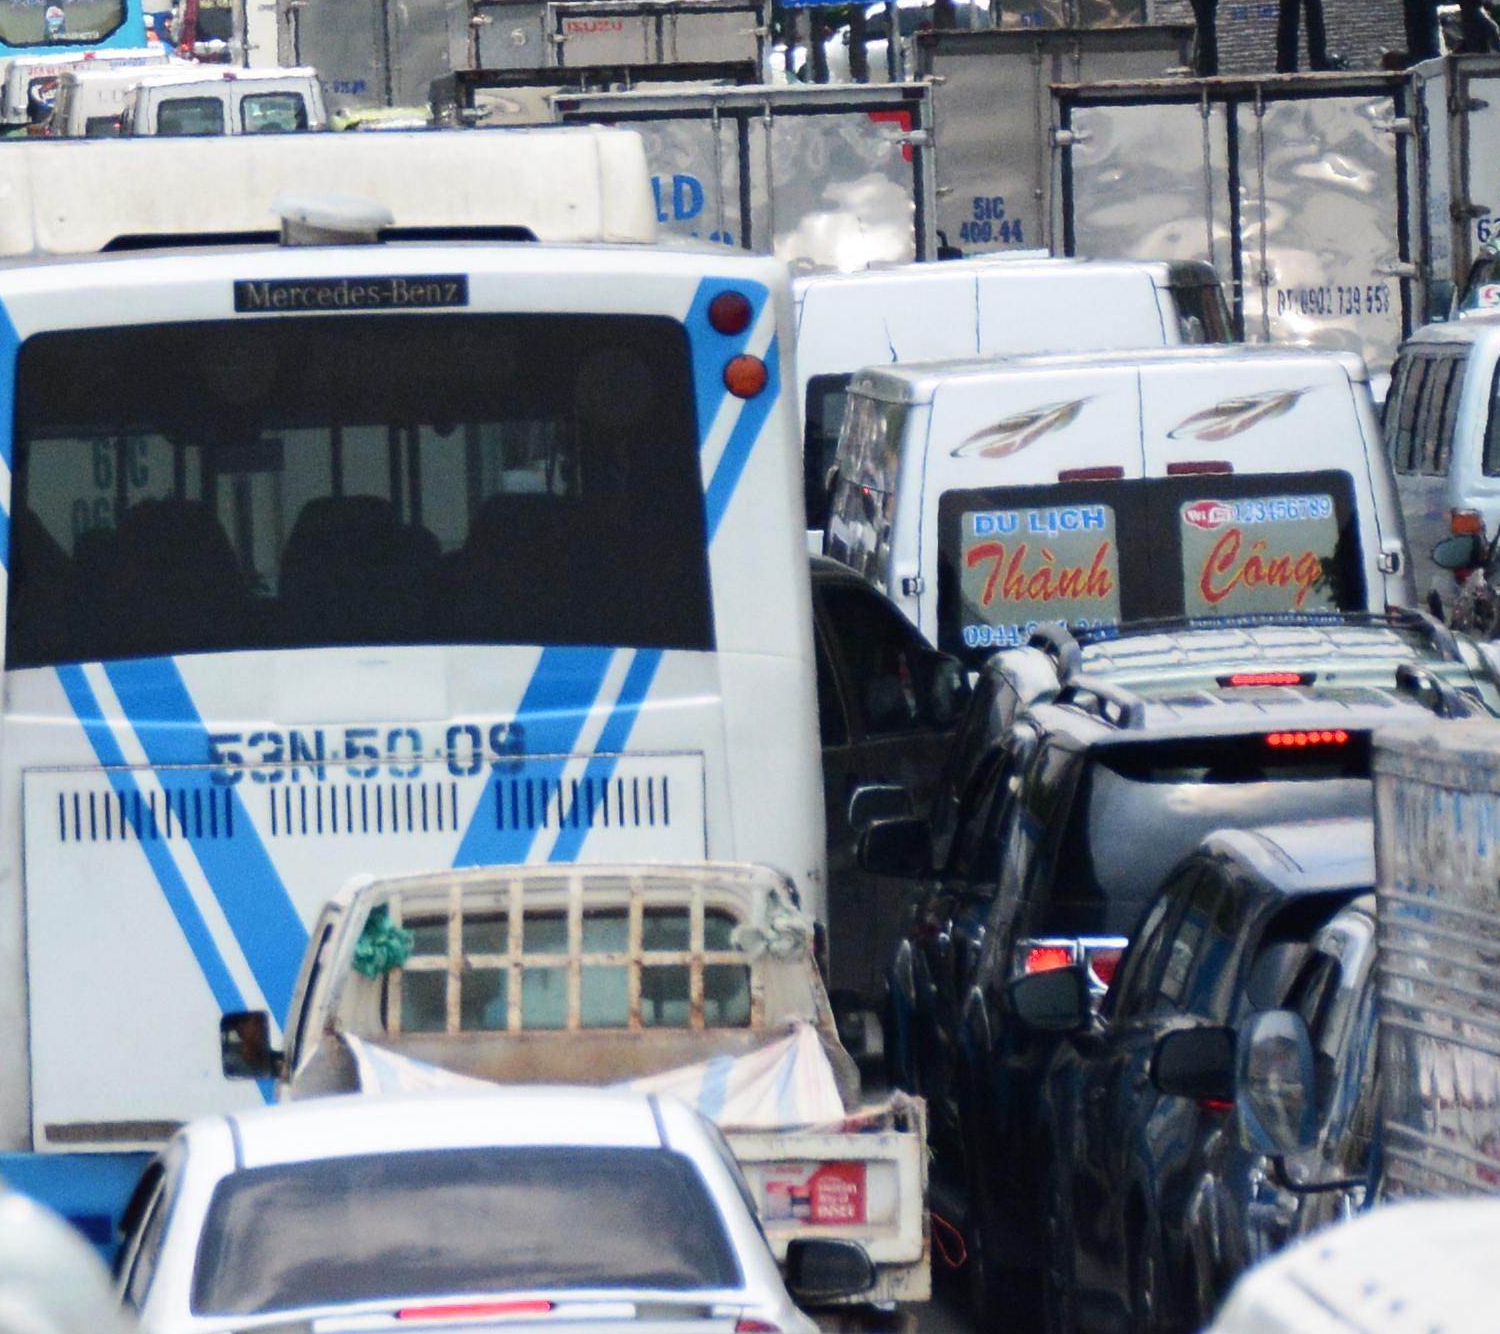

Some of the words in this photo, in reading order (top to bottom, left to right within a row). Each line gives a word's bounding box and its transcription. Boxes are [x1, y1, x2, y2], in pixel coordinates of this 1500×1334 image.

[972, 196, 1005, 221] 51C
[246, 278, 458, 307] Mercedes-Benz
[974, 512, 1018, 536] DU
[1028, 505, 1106, 538] LỊCH
[967, 540, 1113, 606] Thành
[1200, 528, 1322, 607] Công
